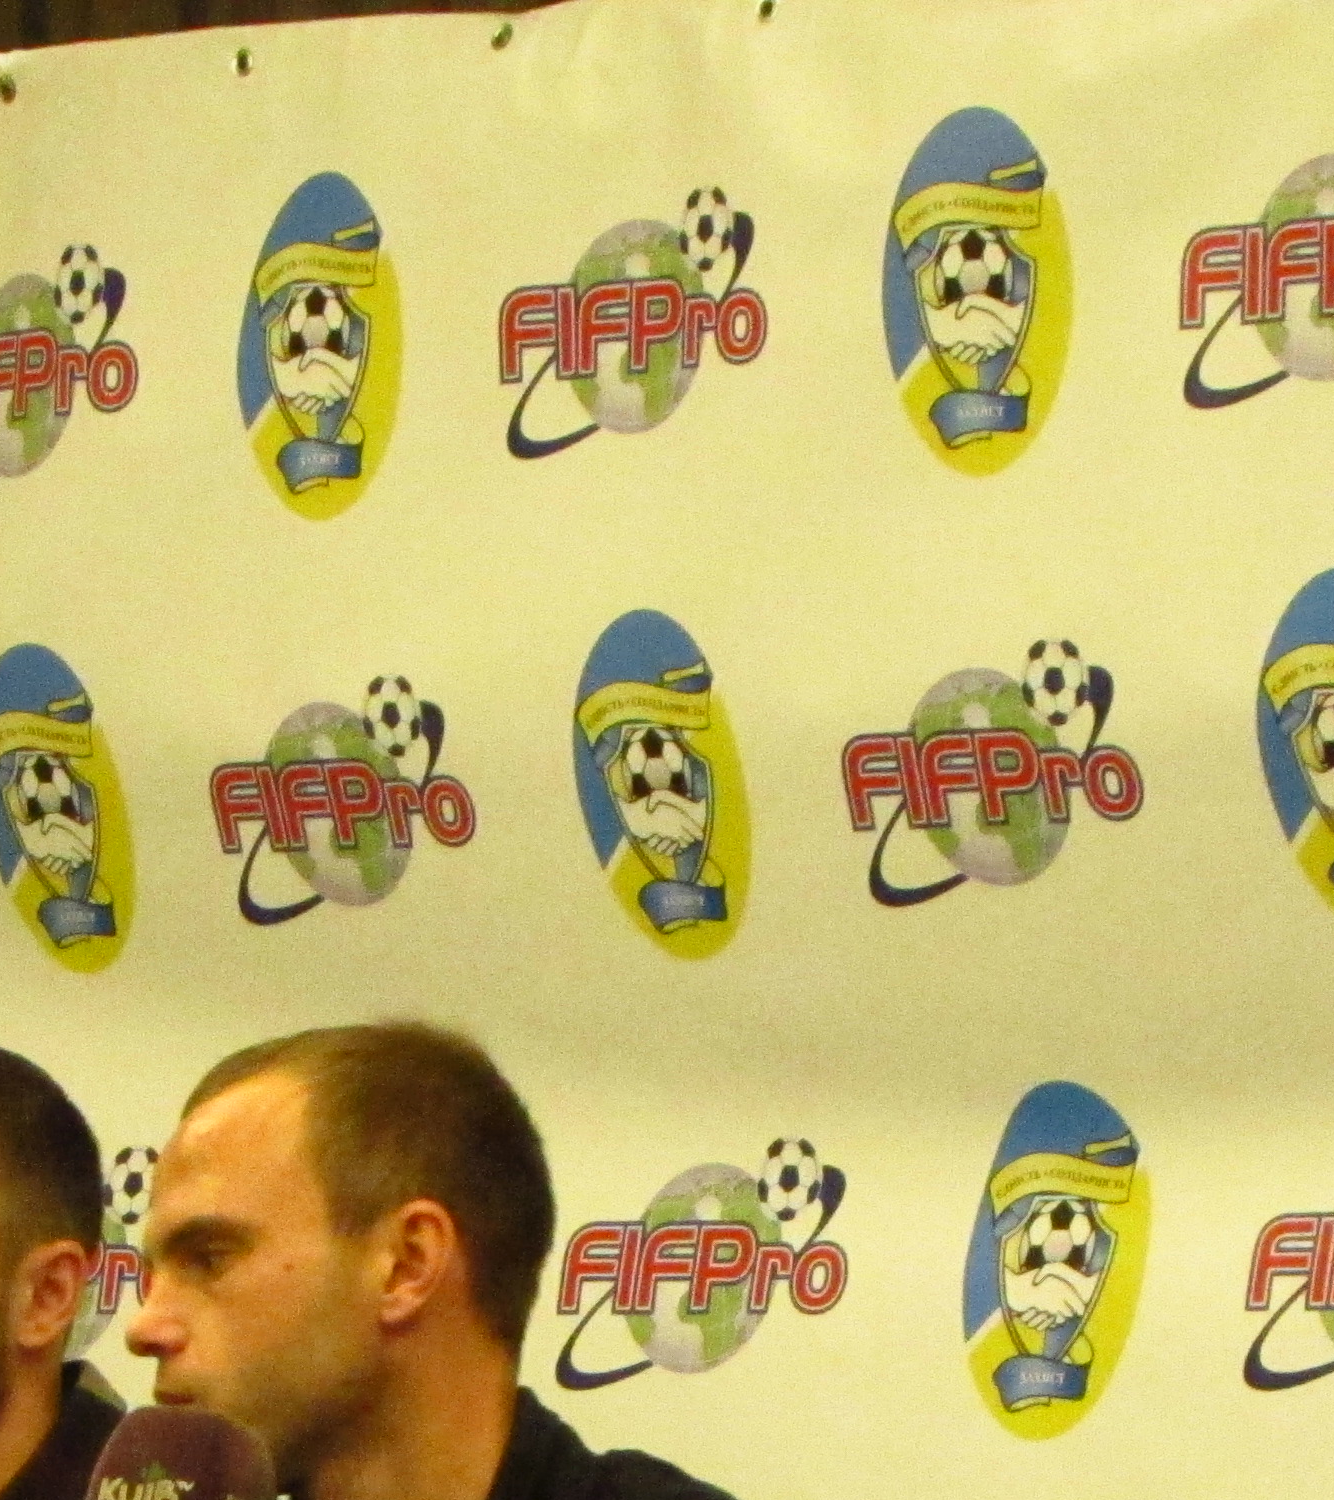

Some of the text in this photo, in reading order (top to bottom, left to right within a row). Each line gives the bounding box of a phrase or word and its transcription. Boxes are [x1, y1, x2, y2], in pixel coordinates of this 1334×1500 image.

[496, 275, 768, 380] FIFPro
[209, 758, 476, 850] FIFPro
[842, 728, 1142, 830] FIFPro
[557, 1220, 847, 1317] FIFPro
